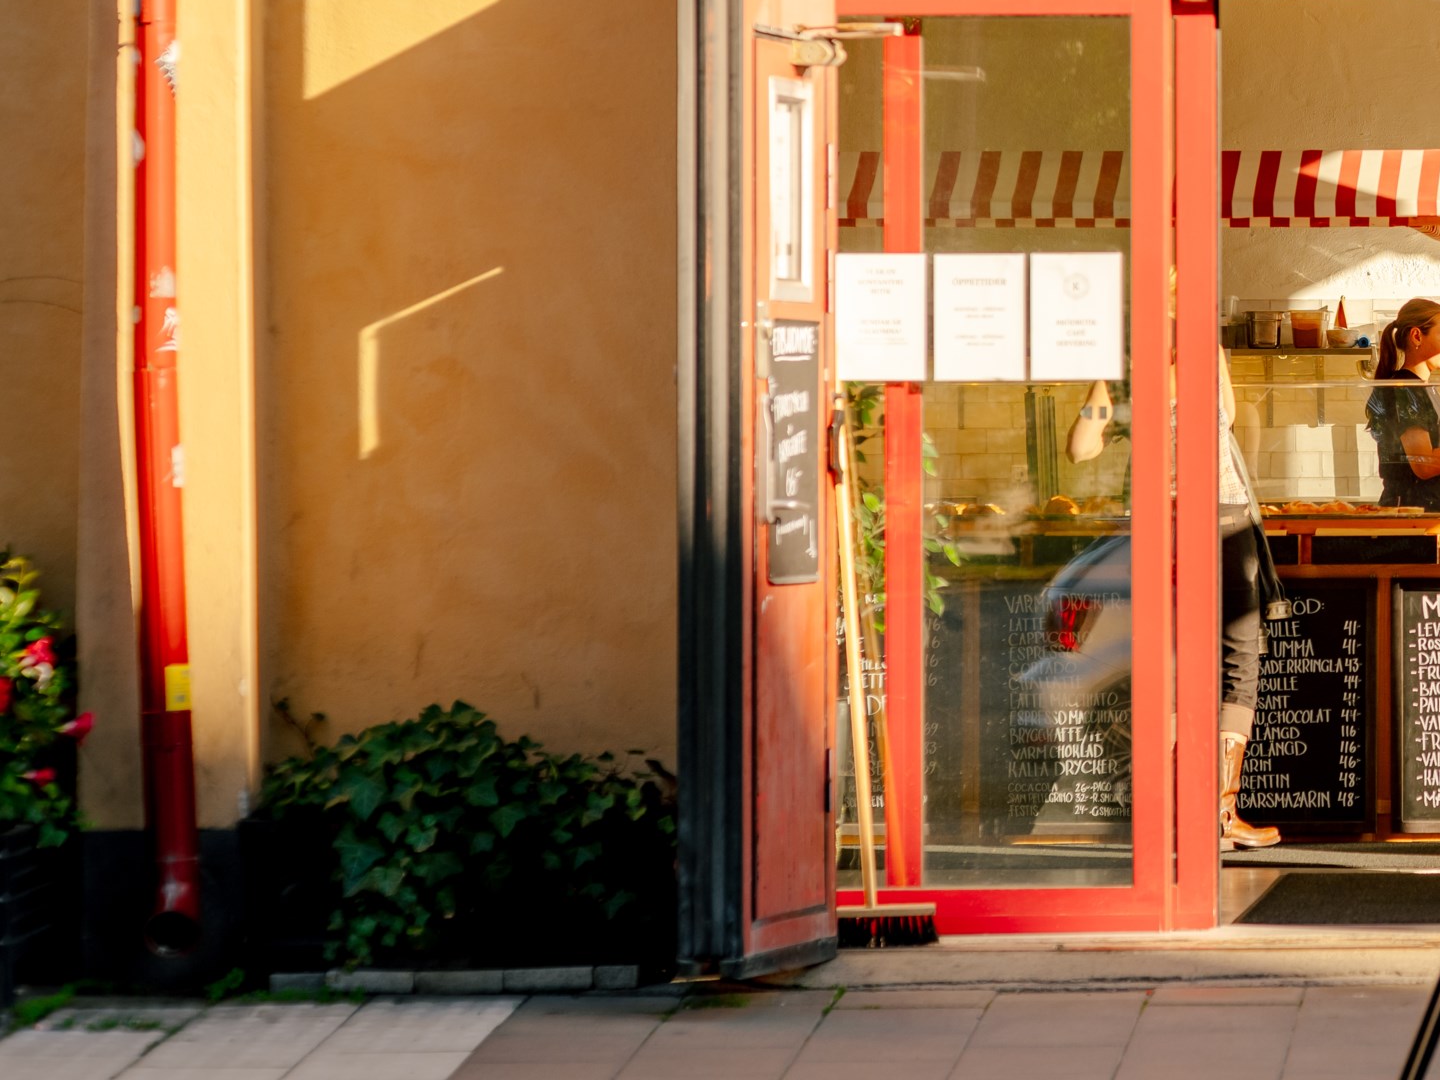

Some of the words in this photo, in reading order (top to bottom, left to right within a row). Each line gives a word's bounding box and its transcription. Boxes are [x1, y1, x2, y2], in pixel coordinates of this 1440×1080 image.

[1004, 594, 1053, 614] VARMA
[1290, 596, 1325, 615] ÖD:
[1273, 639, 1315, 658] UMMA
[1255, 695, 1291, 710] SANT
[1267, 708, 1332, 724] CHOCOLAT
[1010, 746, 1047, 760] VARM
[1049, 744, 1104, 759] CHOKLAD
[1008, 761, 1049, 778] KALLA
[1242, 758, 1272, 773] ARIN
[1241, 773, 1290, 790] RENTIN
